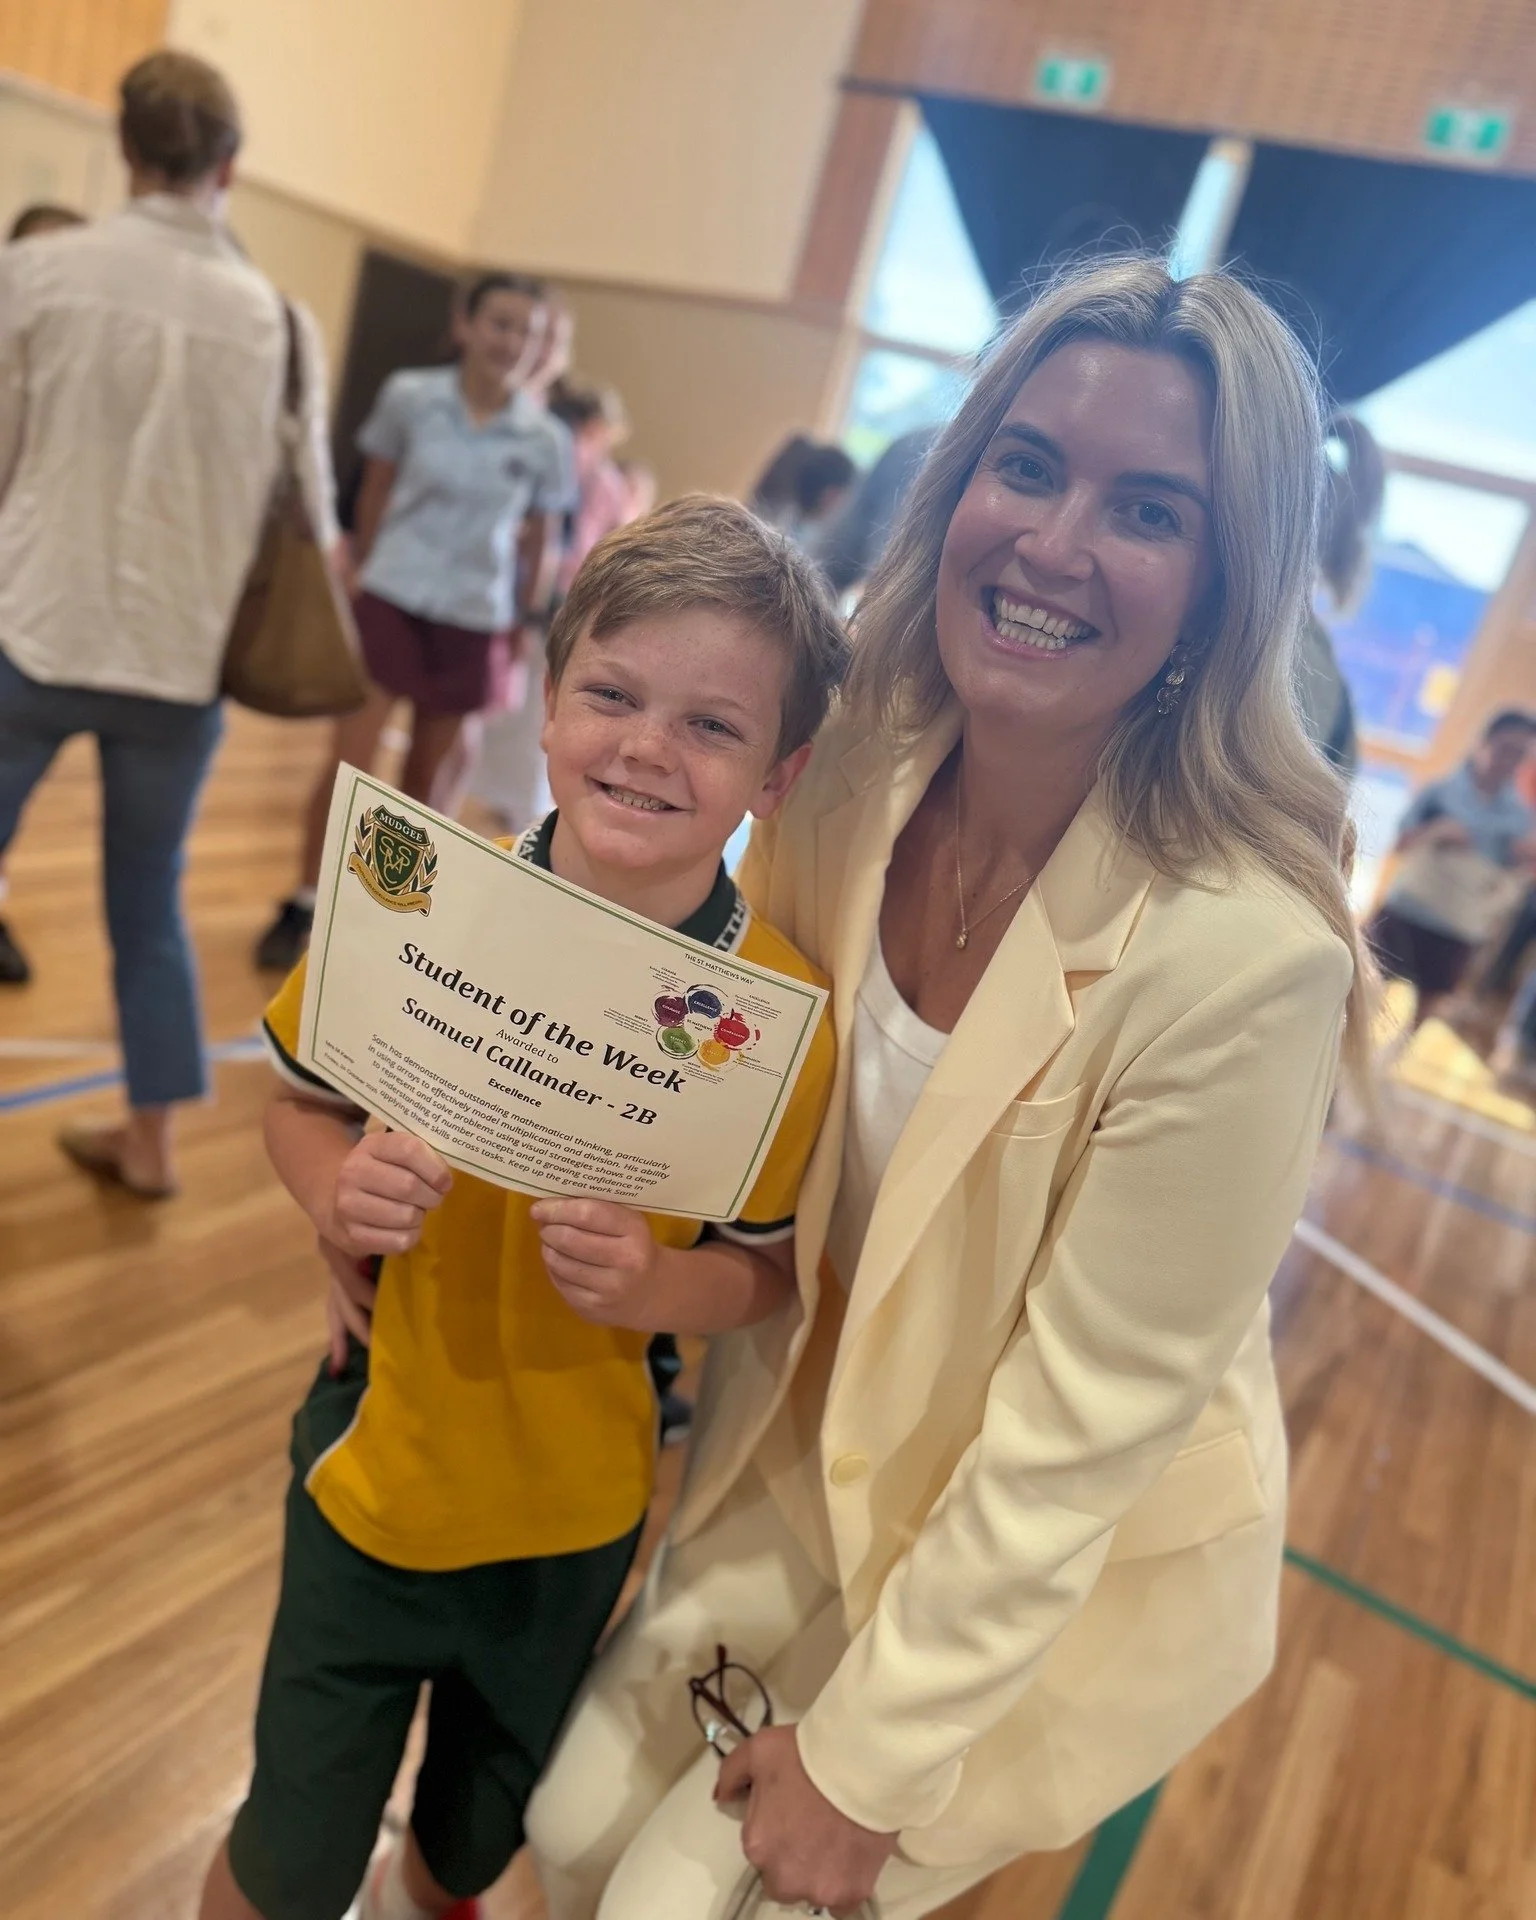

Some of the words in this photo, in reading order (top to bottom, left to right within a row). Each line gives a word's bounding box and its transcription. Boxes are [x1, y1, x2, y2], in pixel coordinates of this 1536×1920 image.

[380, 812, 423, 842] MUDGEE
[398, 942, 506, 1016] Student
[509, 1004, 546, 1035] of
[544, 1021, 594, 1056] the
[602, 1043, 686, 1094] Week
[685, 953, 696, 962] THE
[705, 961, 739, 980] MATTHEWS
[740, 976, 754, 985] WAY
[372, 1034, 388, 1049] Sam
[389, 1044, 403, 1059] has
[404, 1055, 458, 1092] demonstrated
[459, 1089, 510, 1118] outstanding
[510, 1114, 573, 1142] mathematical
[574, 1137, 613, 1156] thinking,
[615, 1151, 670, 1170] particularly
[402, 997, 484, 1054] Samuel
[486, 1044, 603, 1107] Callander
[620, 1102, 658, 1125] 2B
[487, 1078, 542, 1108] Excellence
[495, 1028, 546, 1058] Awarded
[547, 1052, 559, 1065] to
[368, 1044, 376, 1053] in
[376, 1050, 395, 1068] using
[396, 1064, 421, 1083] arrays
[421, 1080, 430, 1089] to
[431, 1086, 471, 1112] effectively
[472, 1108, 500, 1125] model
[500, 1120, 562, 1150] multiplication
[563, 1146, 582, 1156] and
[584, 1152, 620, 1168] division.
[623, 1163, 638, 1172] His
[640, 1167, 670, 1180] ability
[372, 1060, 380, 1069] to
[381, 1066, 415, 1093] represent
[416, 1090, 432, 1103] and
[432, 1099, 453, 1116] solve
[454, 1112, 494, 1135] problems
[496, 1131, 520, 1147] using
[521, 1141, 548, 1156] visual
[549, 1151, 592, 1170] strategies
[595, 1166, 623, 1178] shows
[634, 1175, 658, 1186] deep
[379, 1077, 430, 1118] understanding
[431, 1112, 442, 1122] of
[441, 1119, 475, 1138] number
[476, 1135, 515, 1155] concepts
[516, 1151, 534, 1162] and
[543, 1162, 581, 1178] growing
[582, 1173, 633, 1189] confidence
[380, 1089, 409, 1115] applying
[410, 1110, 430, 1128] these
[431, 1125, 450, 1140] skills
[452, 1137, 480, 1152] across
[481, 1148, 506, 1163] tasks.
[508, 1160, 530, 1172] Keep
[532, 1168, 544, 1177] up
[545, 1172, 561, 1182] the
[562, 1178, 587, 1189] great
[589, 1184, 612, 1193] work
[614, 1188, 639, 1198] Sam!
